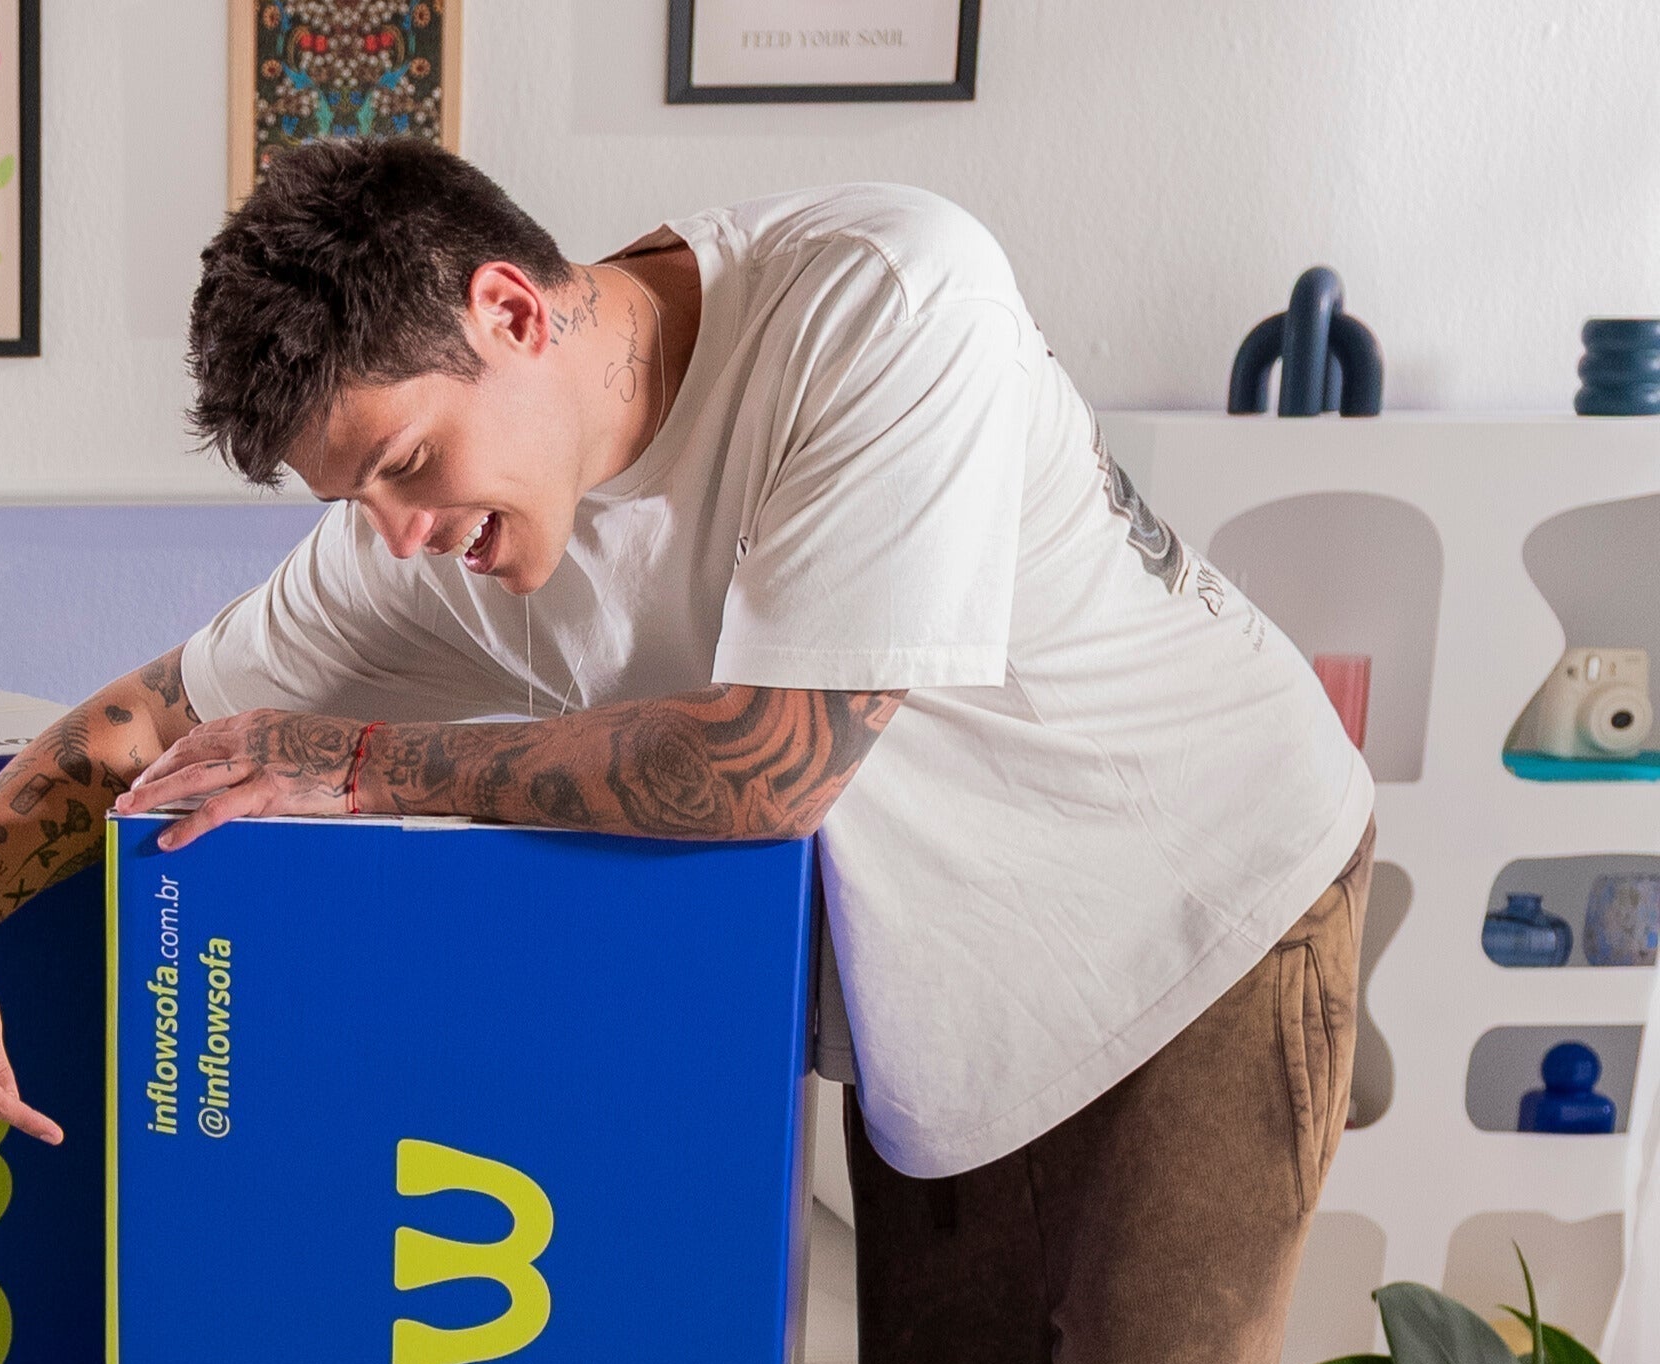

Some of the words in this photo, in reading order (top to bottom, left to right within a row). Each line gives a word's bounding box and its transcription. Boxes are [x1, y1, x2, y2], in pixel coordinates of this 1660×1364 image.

[741, 30, 791, 48] FEED
[797, 29, 850, 47] YOUR
[856, 28, 909, 47] SOUL
[146, 874, 180, 1135] inflowsofa.com.br
[197, 937, 232, 1139] @inflowsofa
